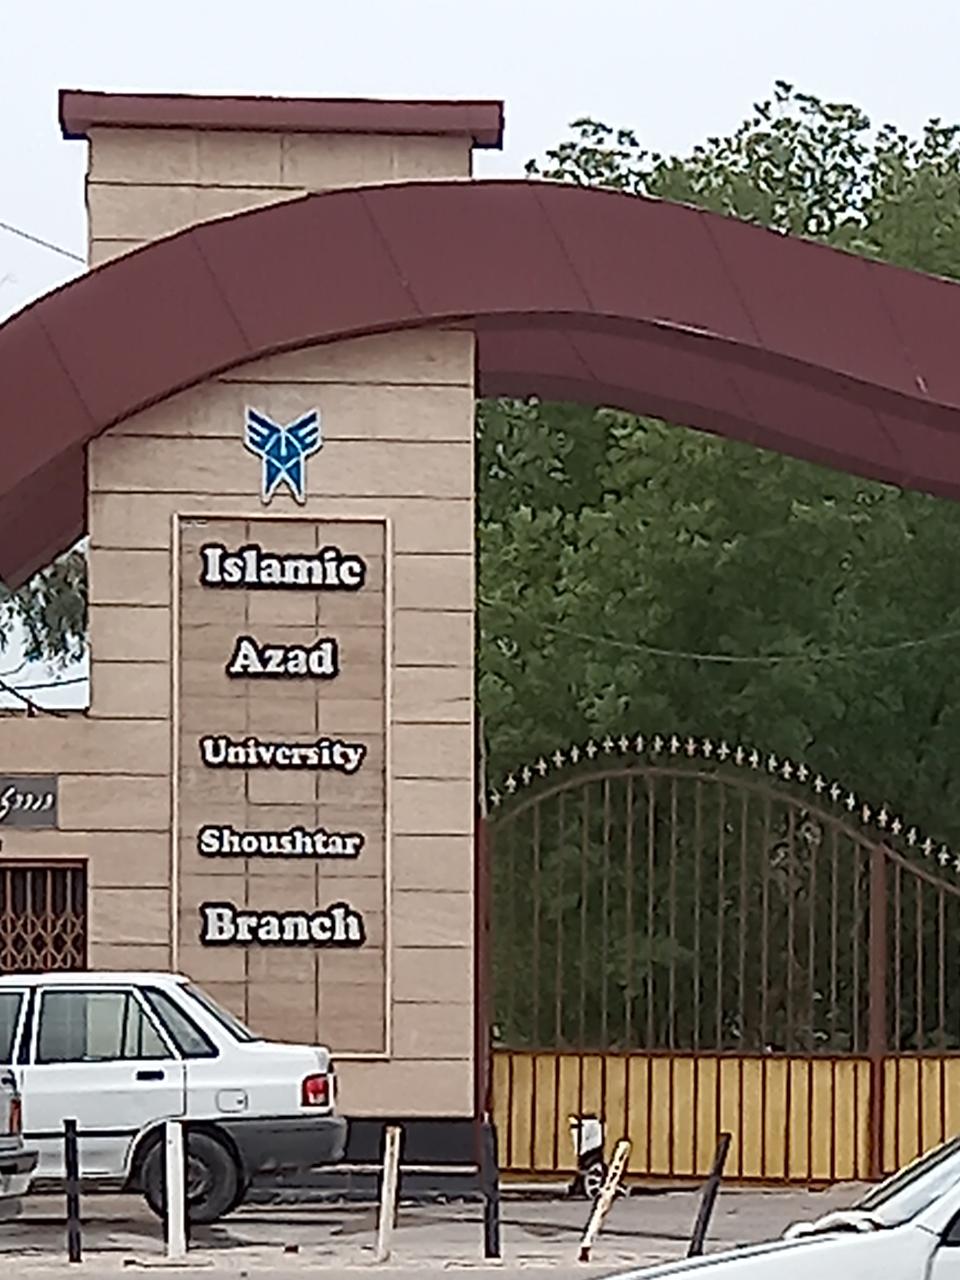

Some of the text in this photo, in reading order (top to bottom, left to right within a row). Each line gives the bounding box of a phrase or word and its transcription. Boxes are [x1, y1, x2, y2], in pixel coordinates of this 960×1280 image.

[202, 545, 364, 589] Islamic
[228, 639, 337, 678] Azad
[201, 737, 365, 772] University
[199, 829, 362, 857] Shoushtar
[202, 903, 364, 946] Branch
